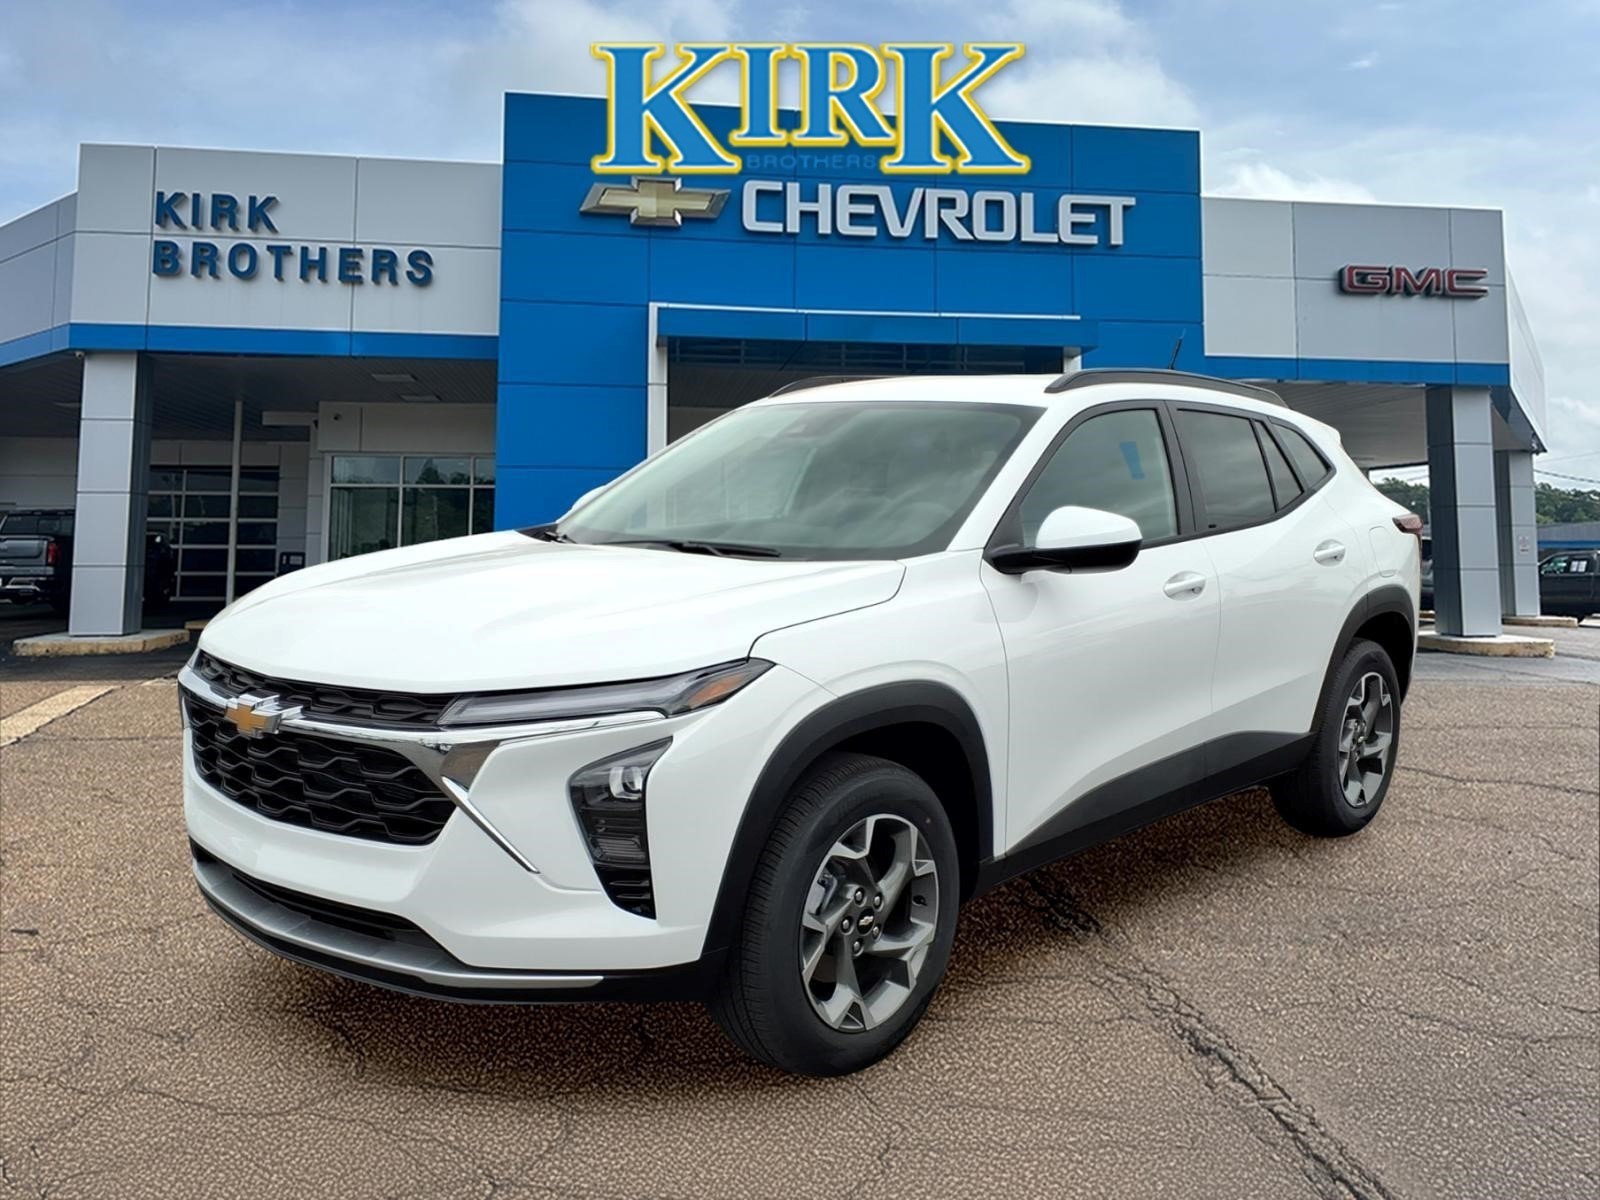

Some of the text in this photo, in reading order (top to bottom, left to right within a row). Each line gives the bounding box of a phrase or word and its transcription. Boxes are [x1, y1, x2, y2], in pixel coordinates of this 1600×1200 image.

[155, 191, 279, 233] KIRK
[742, 179, 1136, 246] CHEVROLET
[152, 240, 434, 286] BROTHERS
[1339, 264, 1488, 298] GMC
